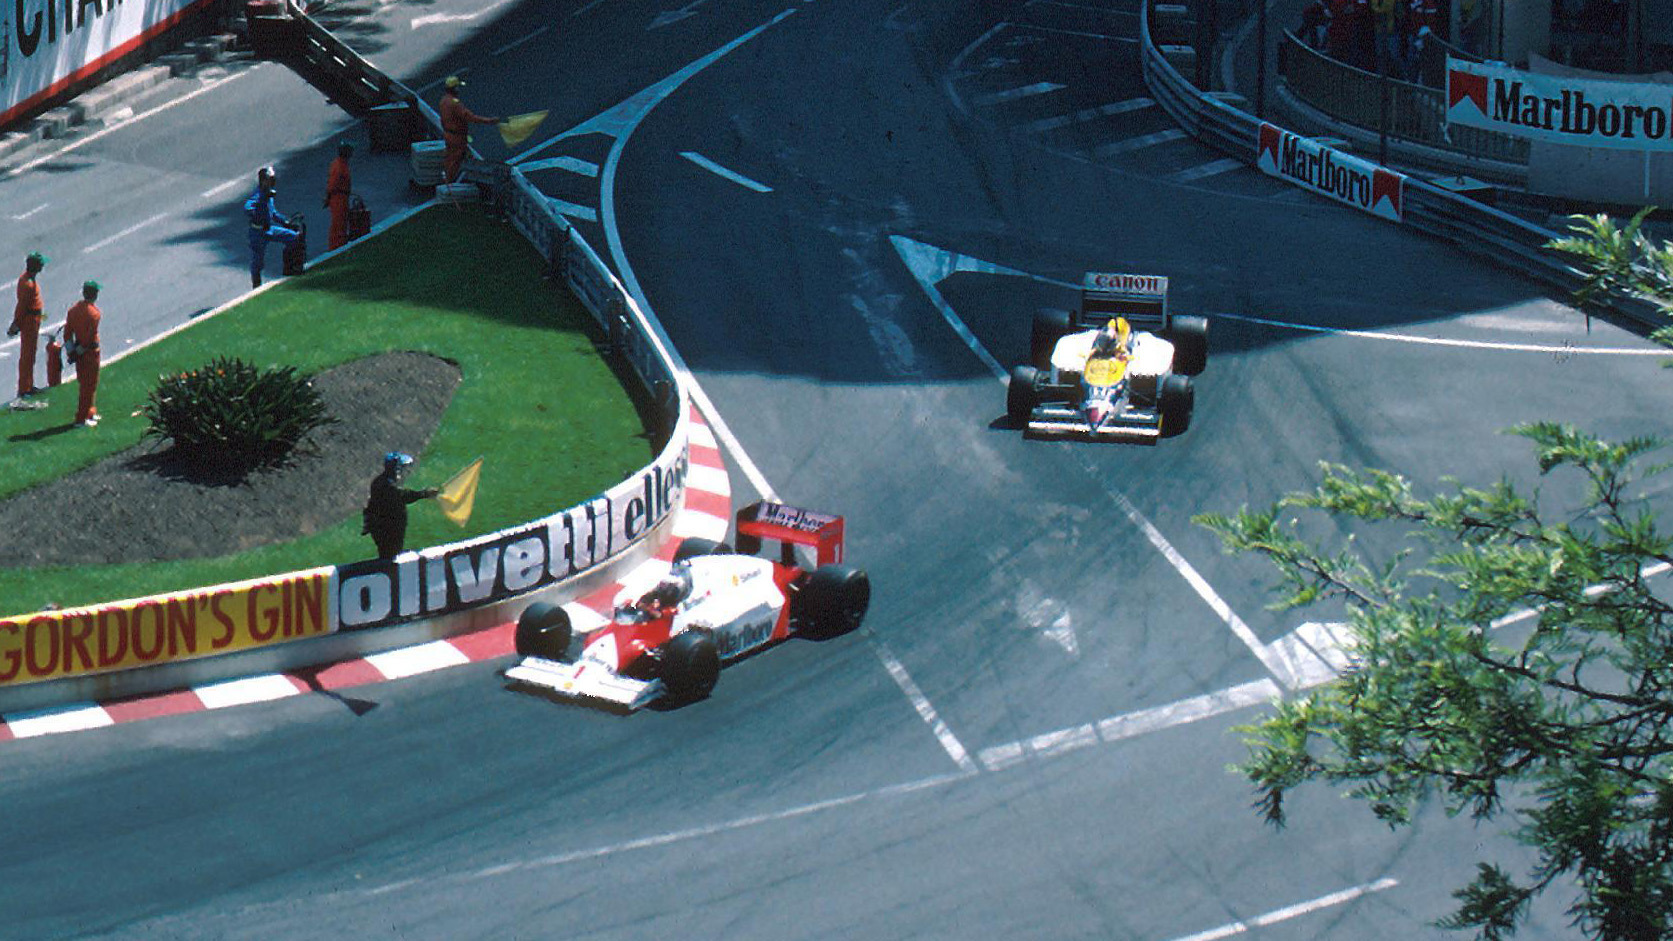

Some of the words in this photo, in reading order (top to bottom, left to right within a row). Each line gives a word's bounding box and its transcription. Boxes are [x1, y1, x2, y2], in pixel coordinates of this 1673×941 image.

[1493, 78, 1666, 139] Marlboro
[1281, 133, 1370, 207] Marlboro
[340, 498, 610, 626] olivetti
[0, 589, 235, 681] GORDON'S
[247, 574, 323, 641] GIN
